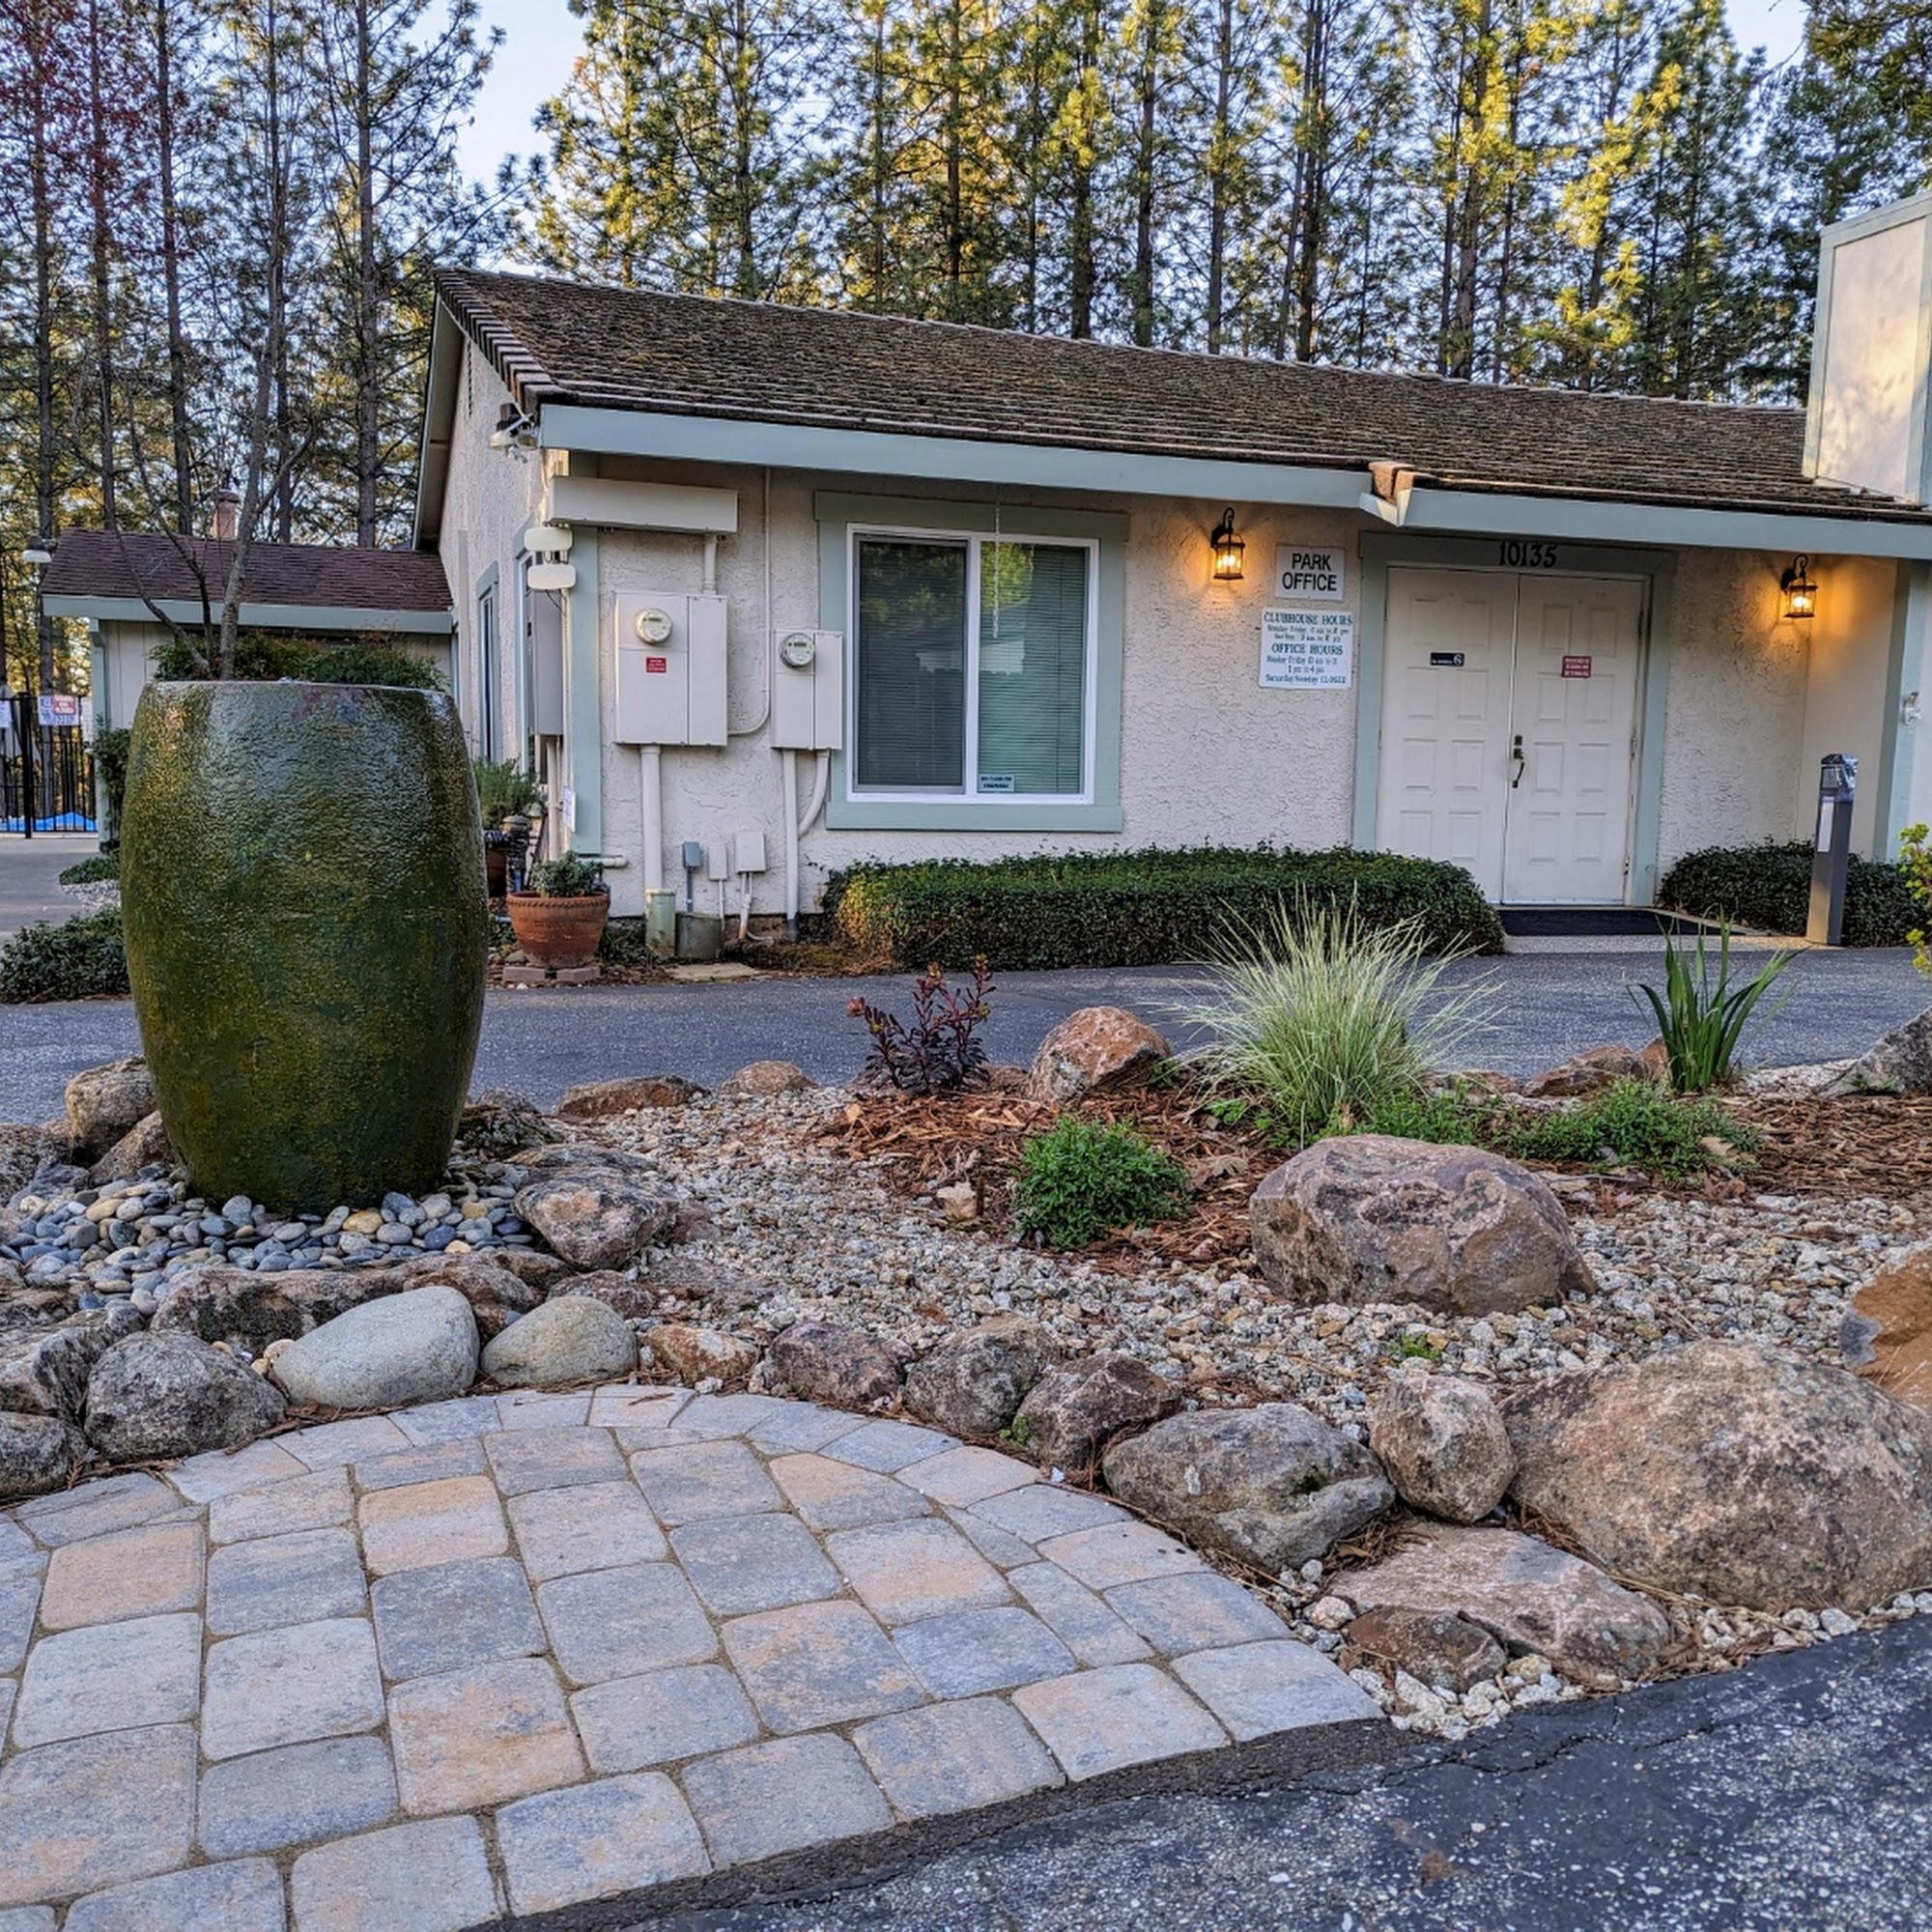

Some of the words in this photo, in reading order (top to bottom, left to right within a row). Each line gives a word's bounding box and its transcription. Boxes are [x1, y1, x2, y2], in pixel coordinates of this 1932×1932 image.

[1292, 553, 1332, 572] PARK
[1498, 541, 1557, 568] 10135
[1282, 572, 1337, 591] OFFICE
[1264, 611, 1319, 625] CLUBHOUSE
[1321, 614, 1353, 626] HOURS
[1271, 642, 1307, 654] OFFICE
[1309, 644, 1344, 656] HOURS
